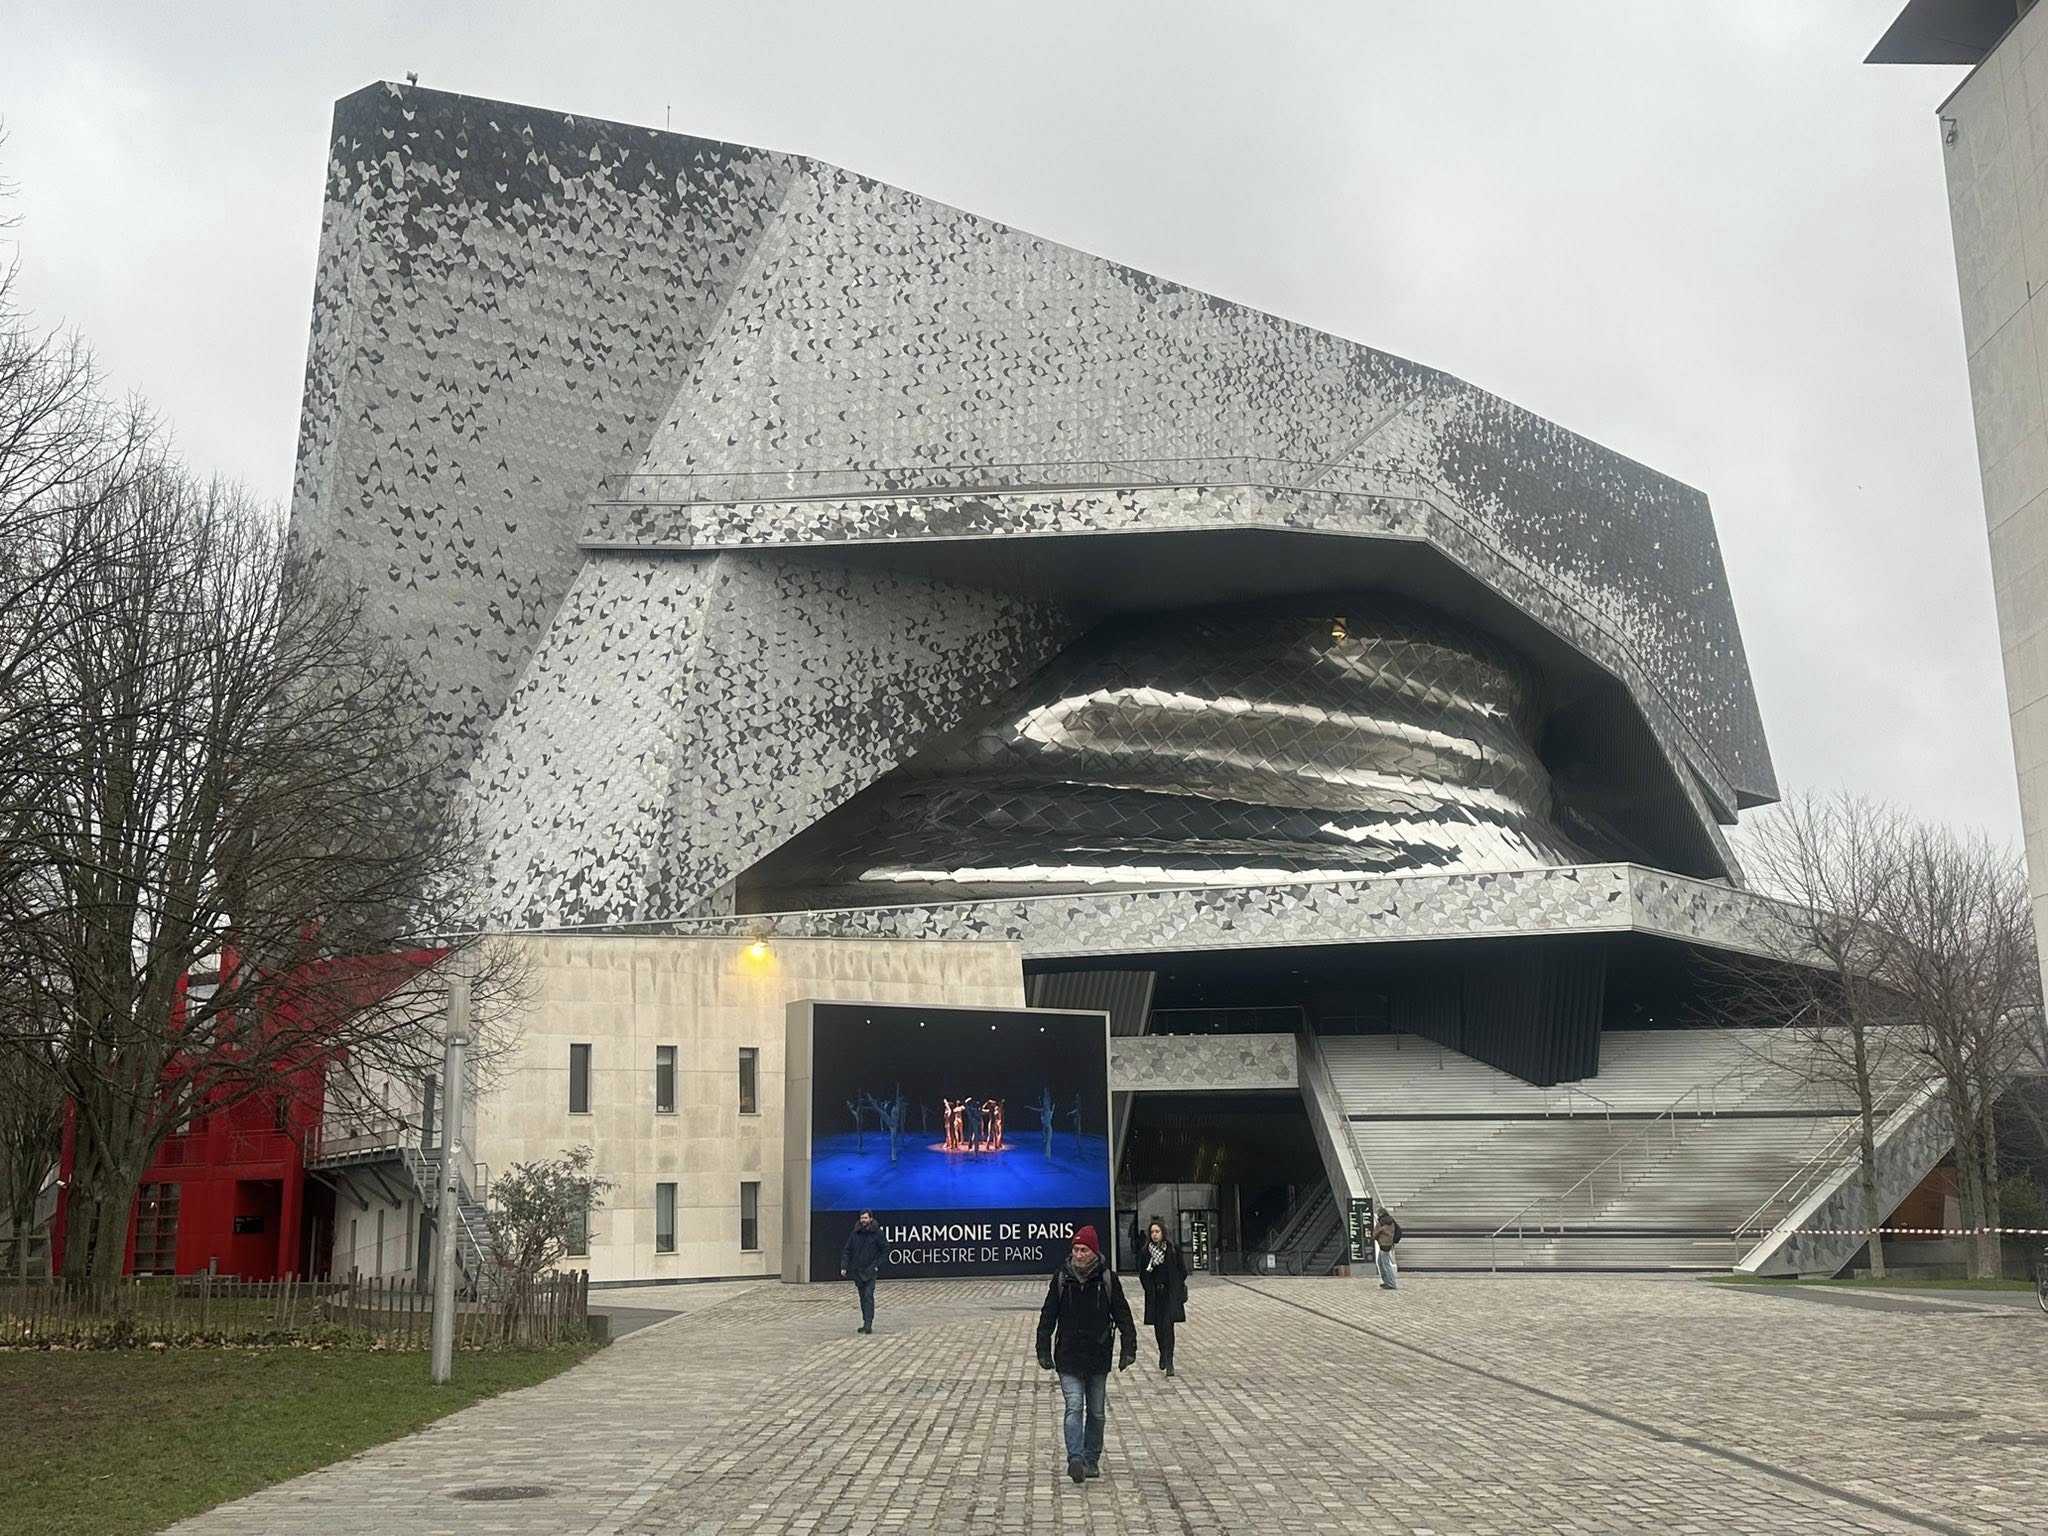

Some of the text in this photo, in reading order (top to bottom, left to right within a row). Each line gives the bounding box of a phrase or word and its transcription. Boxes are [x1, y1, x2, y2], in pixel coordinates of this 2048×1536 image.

[880, 1222, 1074, 1242] LHARMONIE DE PARIS
[889, 1245, 1043, 1265] ORCHESTRE DE PARIS
